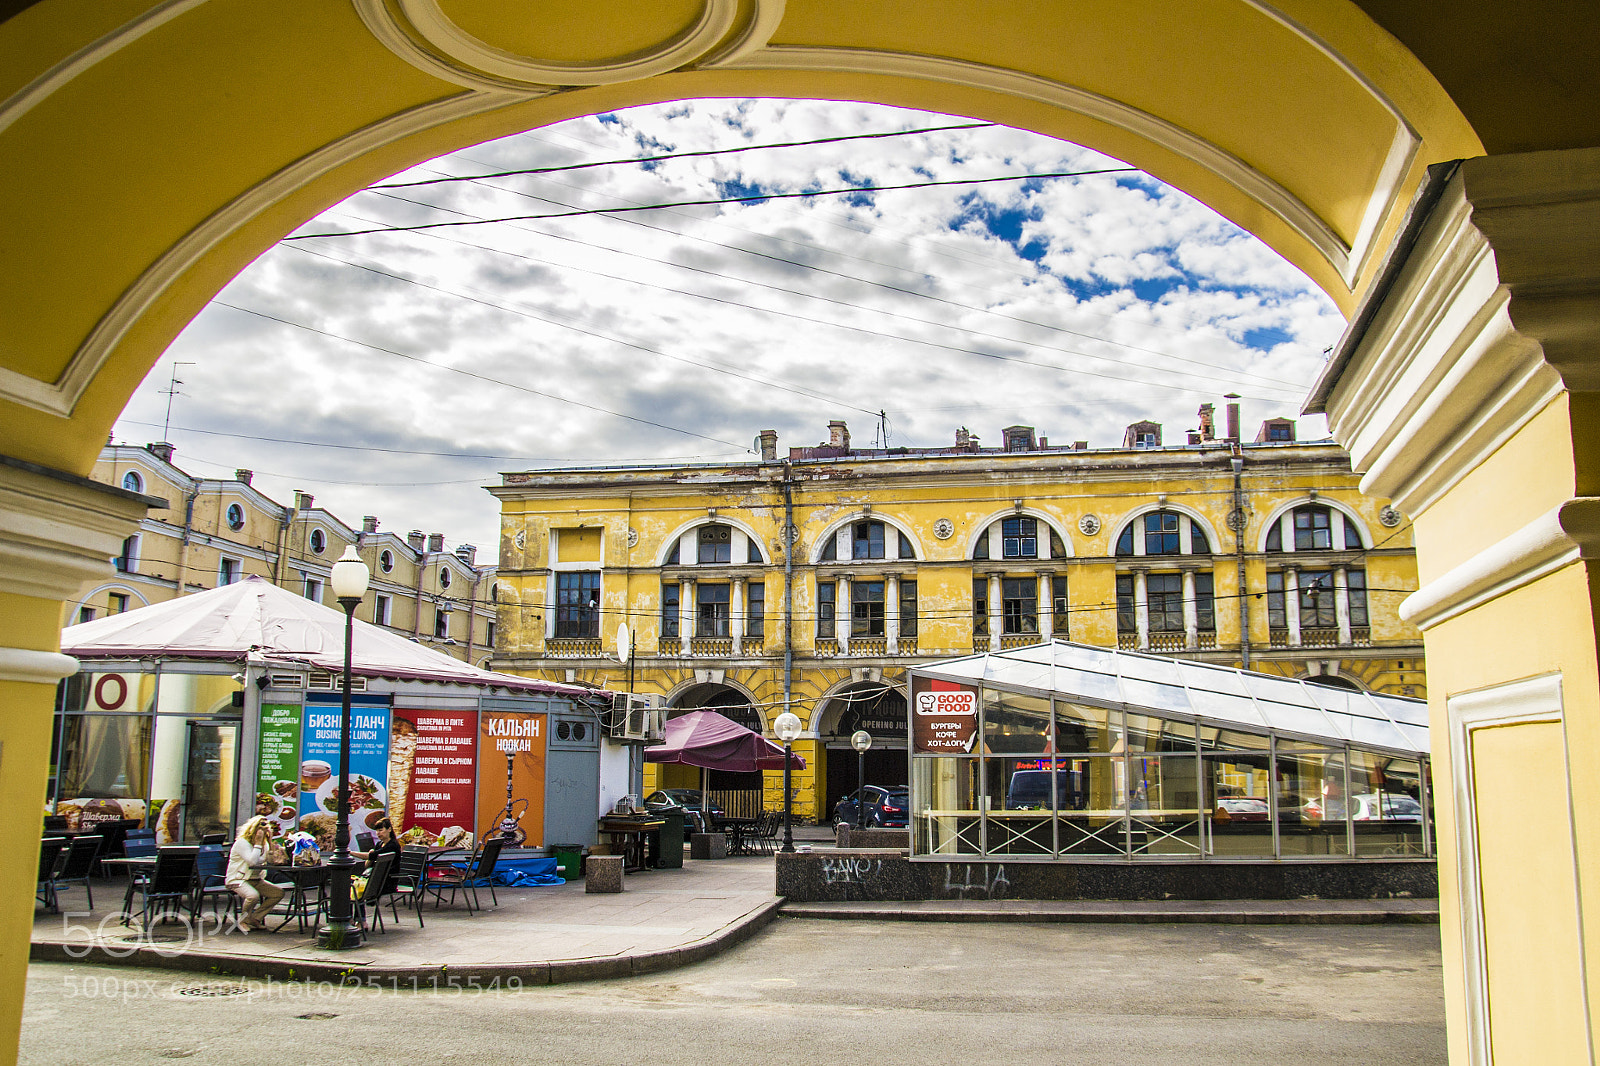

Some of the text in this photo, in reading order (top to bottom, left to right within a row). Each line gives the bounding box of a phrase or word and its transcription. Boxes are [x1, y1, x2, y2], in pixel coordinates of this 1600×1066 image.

[938, 694, 972, 703] GOOD
[938, 704, 970, 712] FOOD
[354, 716, 384, 729] ЛАНЧ
[417, 718, 444, 726] ШАВЕРМА
[862, 720, 894, 729] OPENING
[488, 718, 540, 736] КАЛЬЯН
[353, 730, 376, 740] LUNCH
[496, 738, 531, 752] HOOKAH
